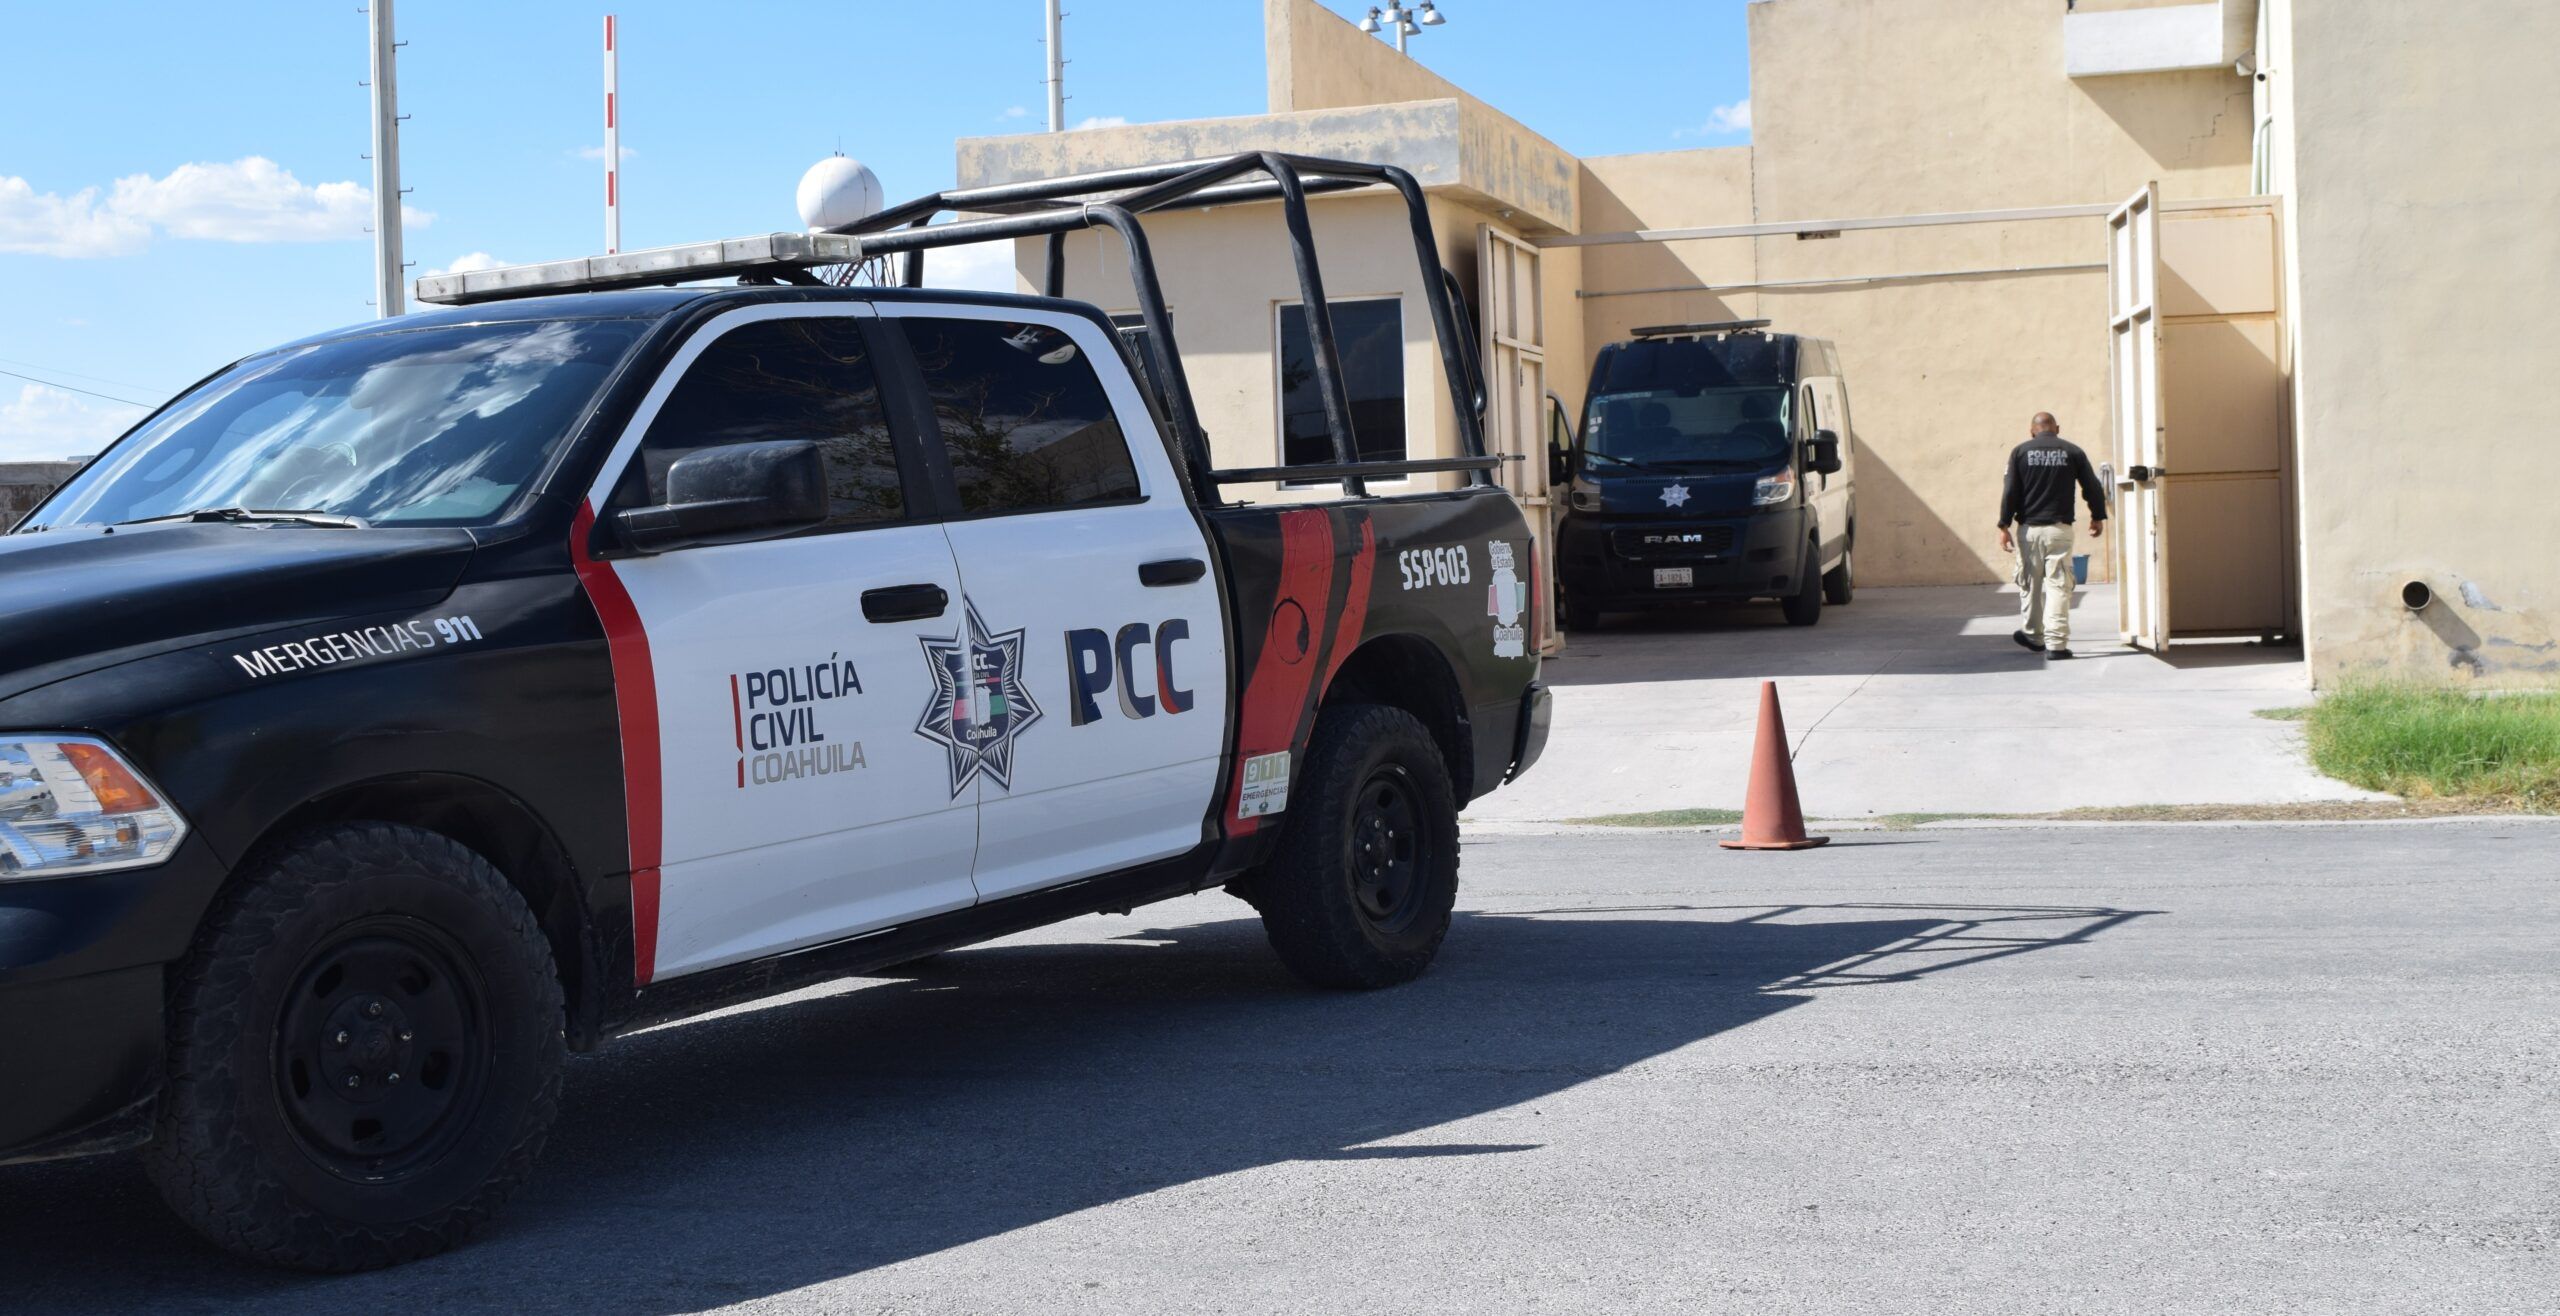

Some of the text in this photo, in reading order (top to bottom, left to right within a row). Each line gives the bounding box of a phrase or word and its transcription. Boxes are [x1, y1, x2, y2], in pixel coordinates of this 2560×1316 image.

[2027, 449, 2068, 459] POLICÍA
[2028, 458, 2068, 466] ESTATAL
[1644, 534, 1702, 543] RAM
[1399, 545, 1471, 590] SSP603
[233, 615, 483, 678] MERGENCIAS 911
[1494, 625, 1523, 641] Coahuila
[746, 652, 863, 709] POLICÍA
[1064, 618, 1194, 727] PCC
[750, 707, 824, 751] CIVIL
[751, 741, 867, 786] COAHUILA
[1247, 756, 1286, 781] 911
[1243, 786, 1288, 801] EMERGENCIAS
